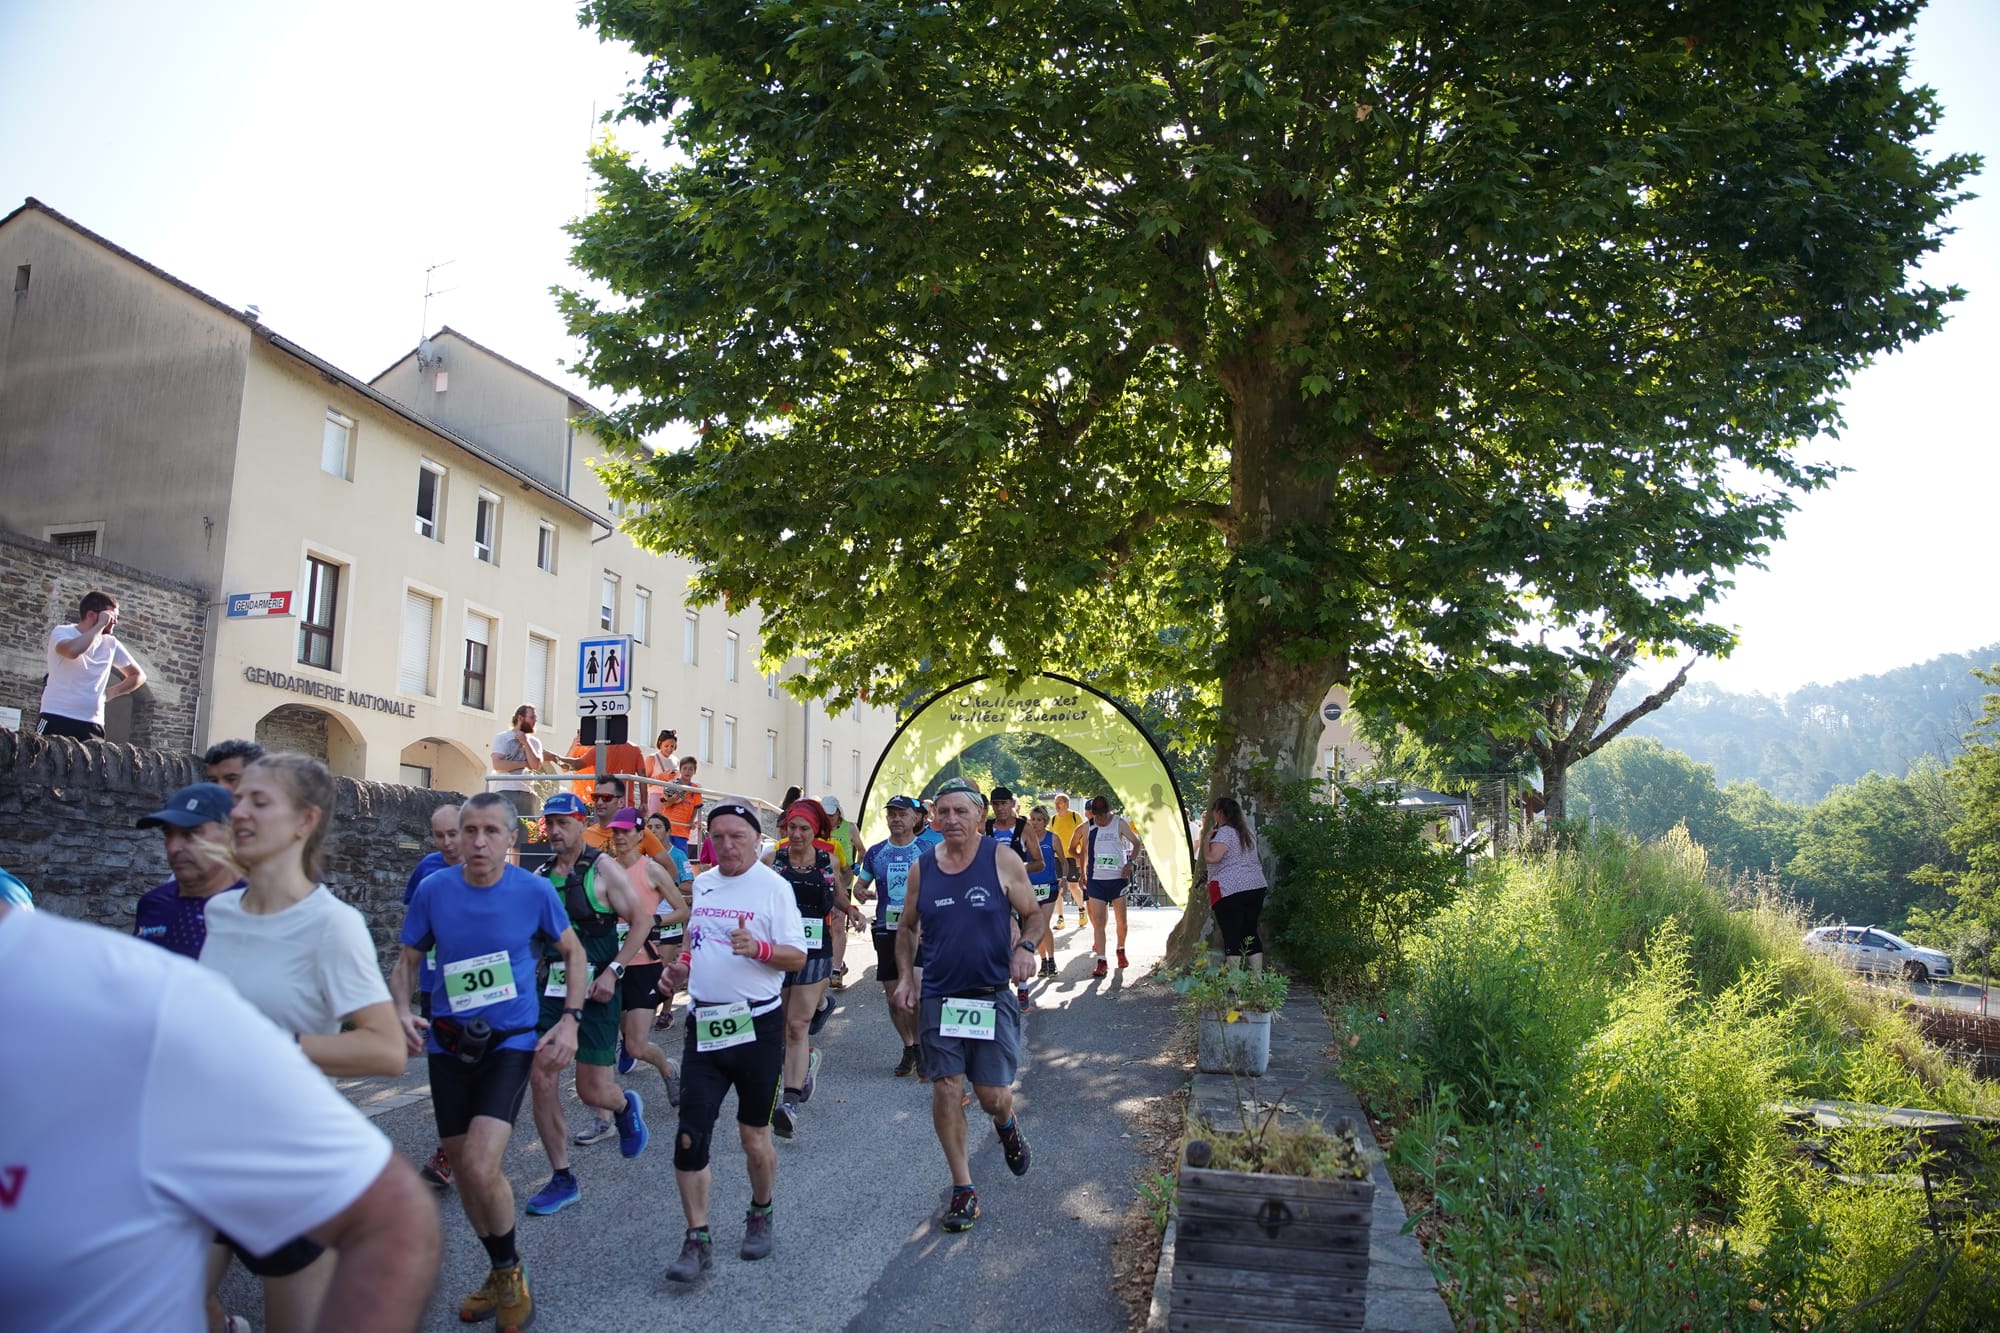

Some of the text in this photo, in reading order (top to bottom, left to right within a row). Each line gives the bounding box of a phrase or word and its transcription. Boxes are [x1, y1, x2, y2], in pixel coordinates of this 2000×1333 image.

[235, 598, 284, 611] GENDARMERIE
[244, 666, 416, 719] GENDARMERIE NATIONALE
[960, 696, 1079, 711] Challenge des
[950, 709, 1006, 722] vallées
[1102, 857, 1114, 865] 72
[693, 906, 756, 921] ENDEKIDN
[461, 968, 495, 992] 30
[956, 1009, 981, 1026] 70
[709, 1018, 737, 1038] 69
